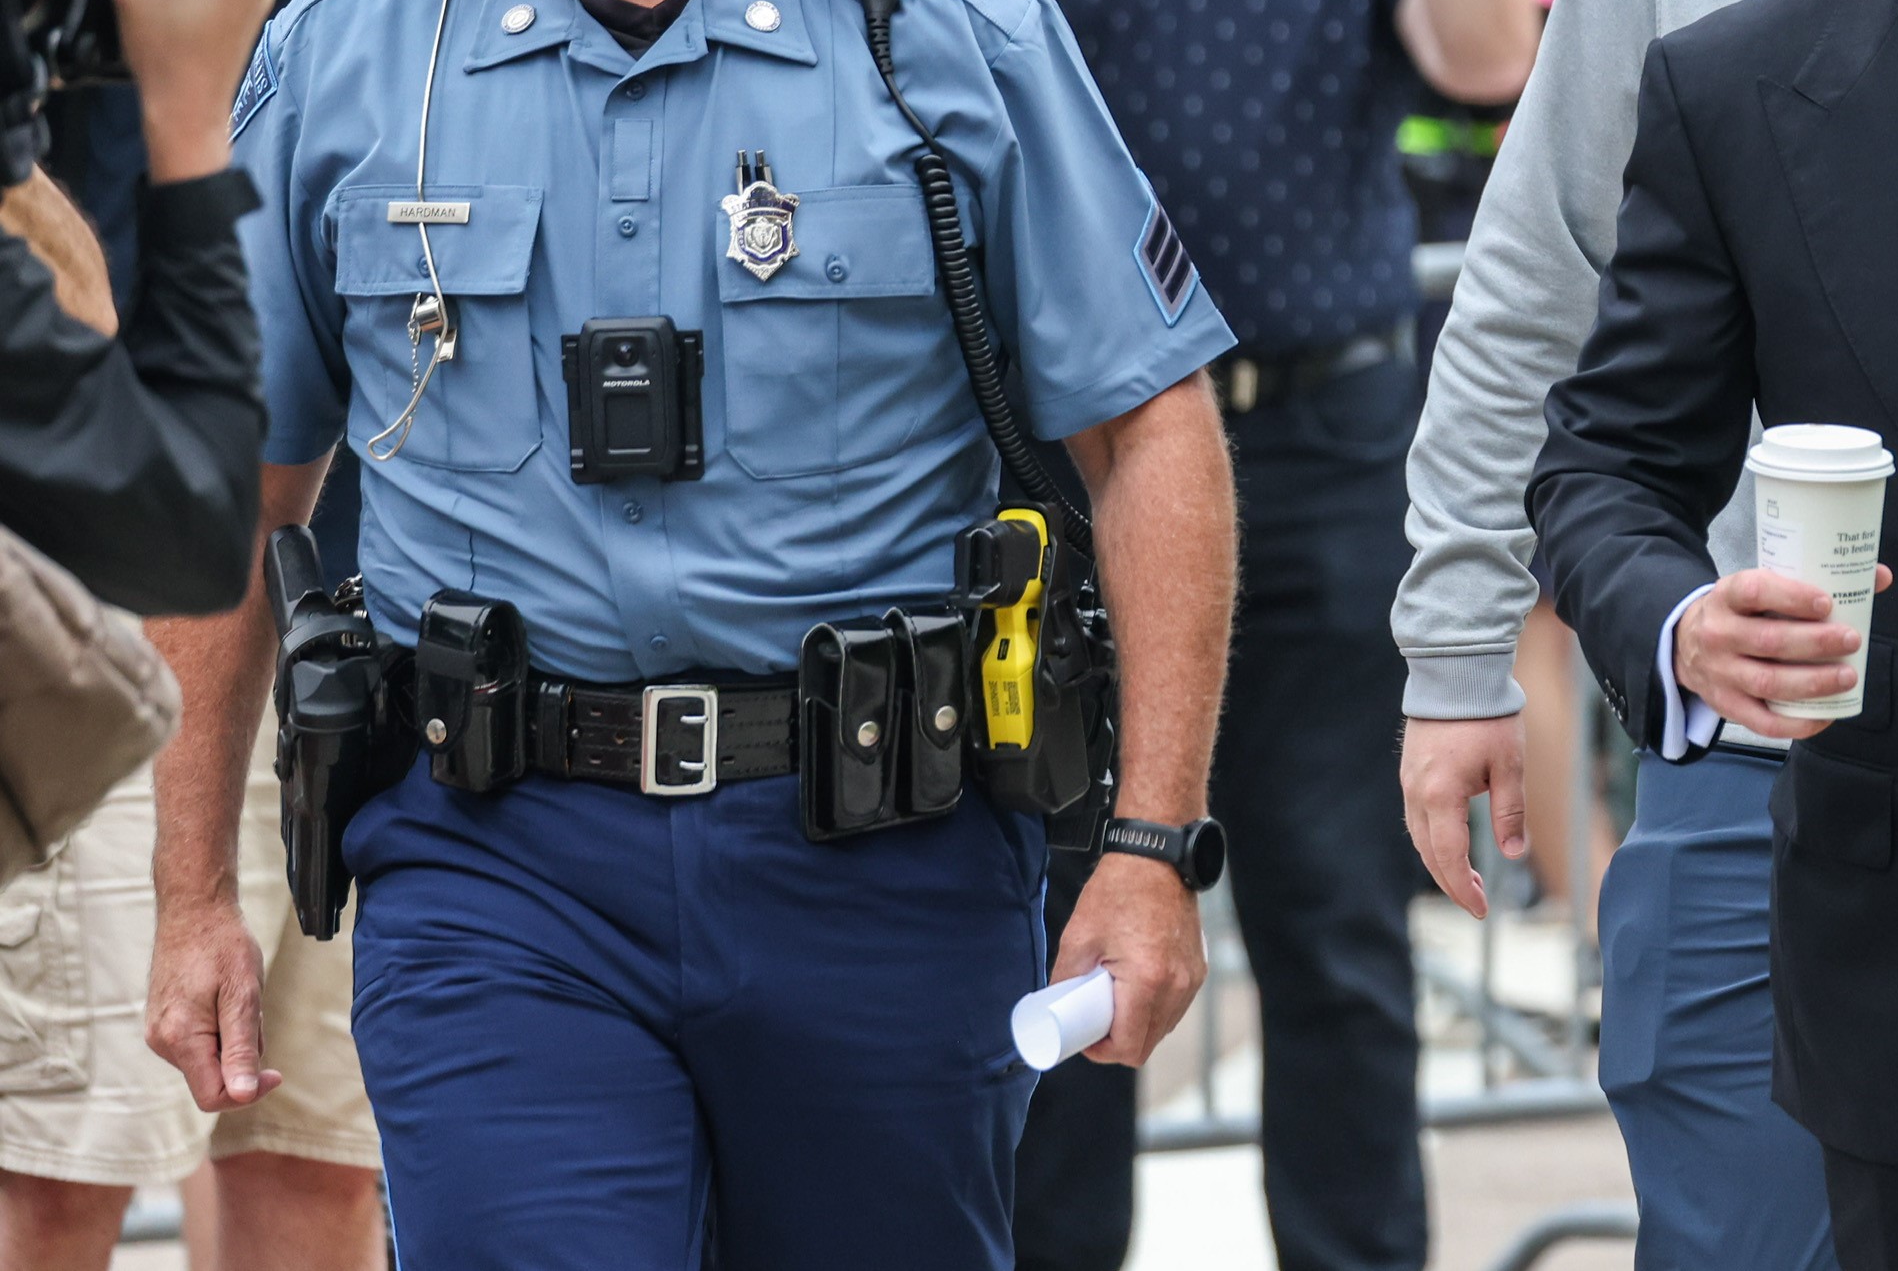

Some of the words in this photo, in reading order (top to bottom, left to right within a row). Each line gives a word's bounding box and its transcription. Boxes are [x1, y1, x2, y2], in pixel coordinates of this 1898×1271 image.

[400, 207, 456, 218] HARDMAN
[603, 379, 650, 388] MOTOROLA
[1837, 532, 1860, 542] That
[1834, 545, 1850, 556] sip
